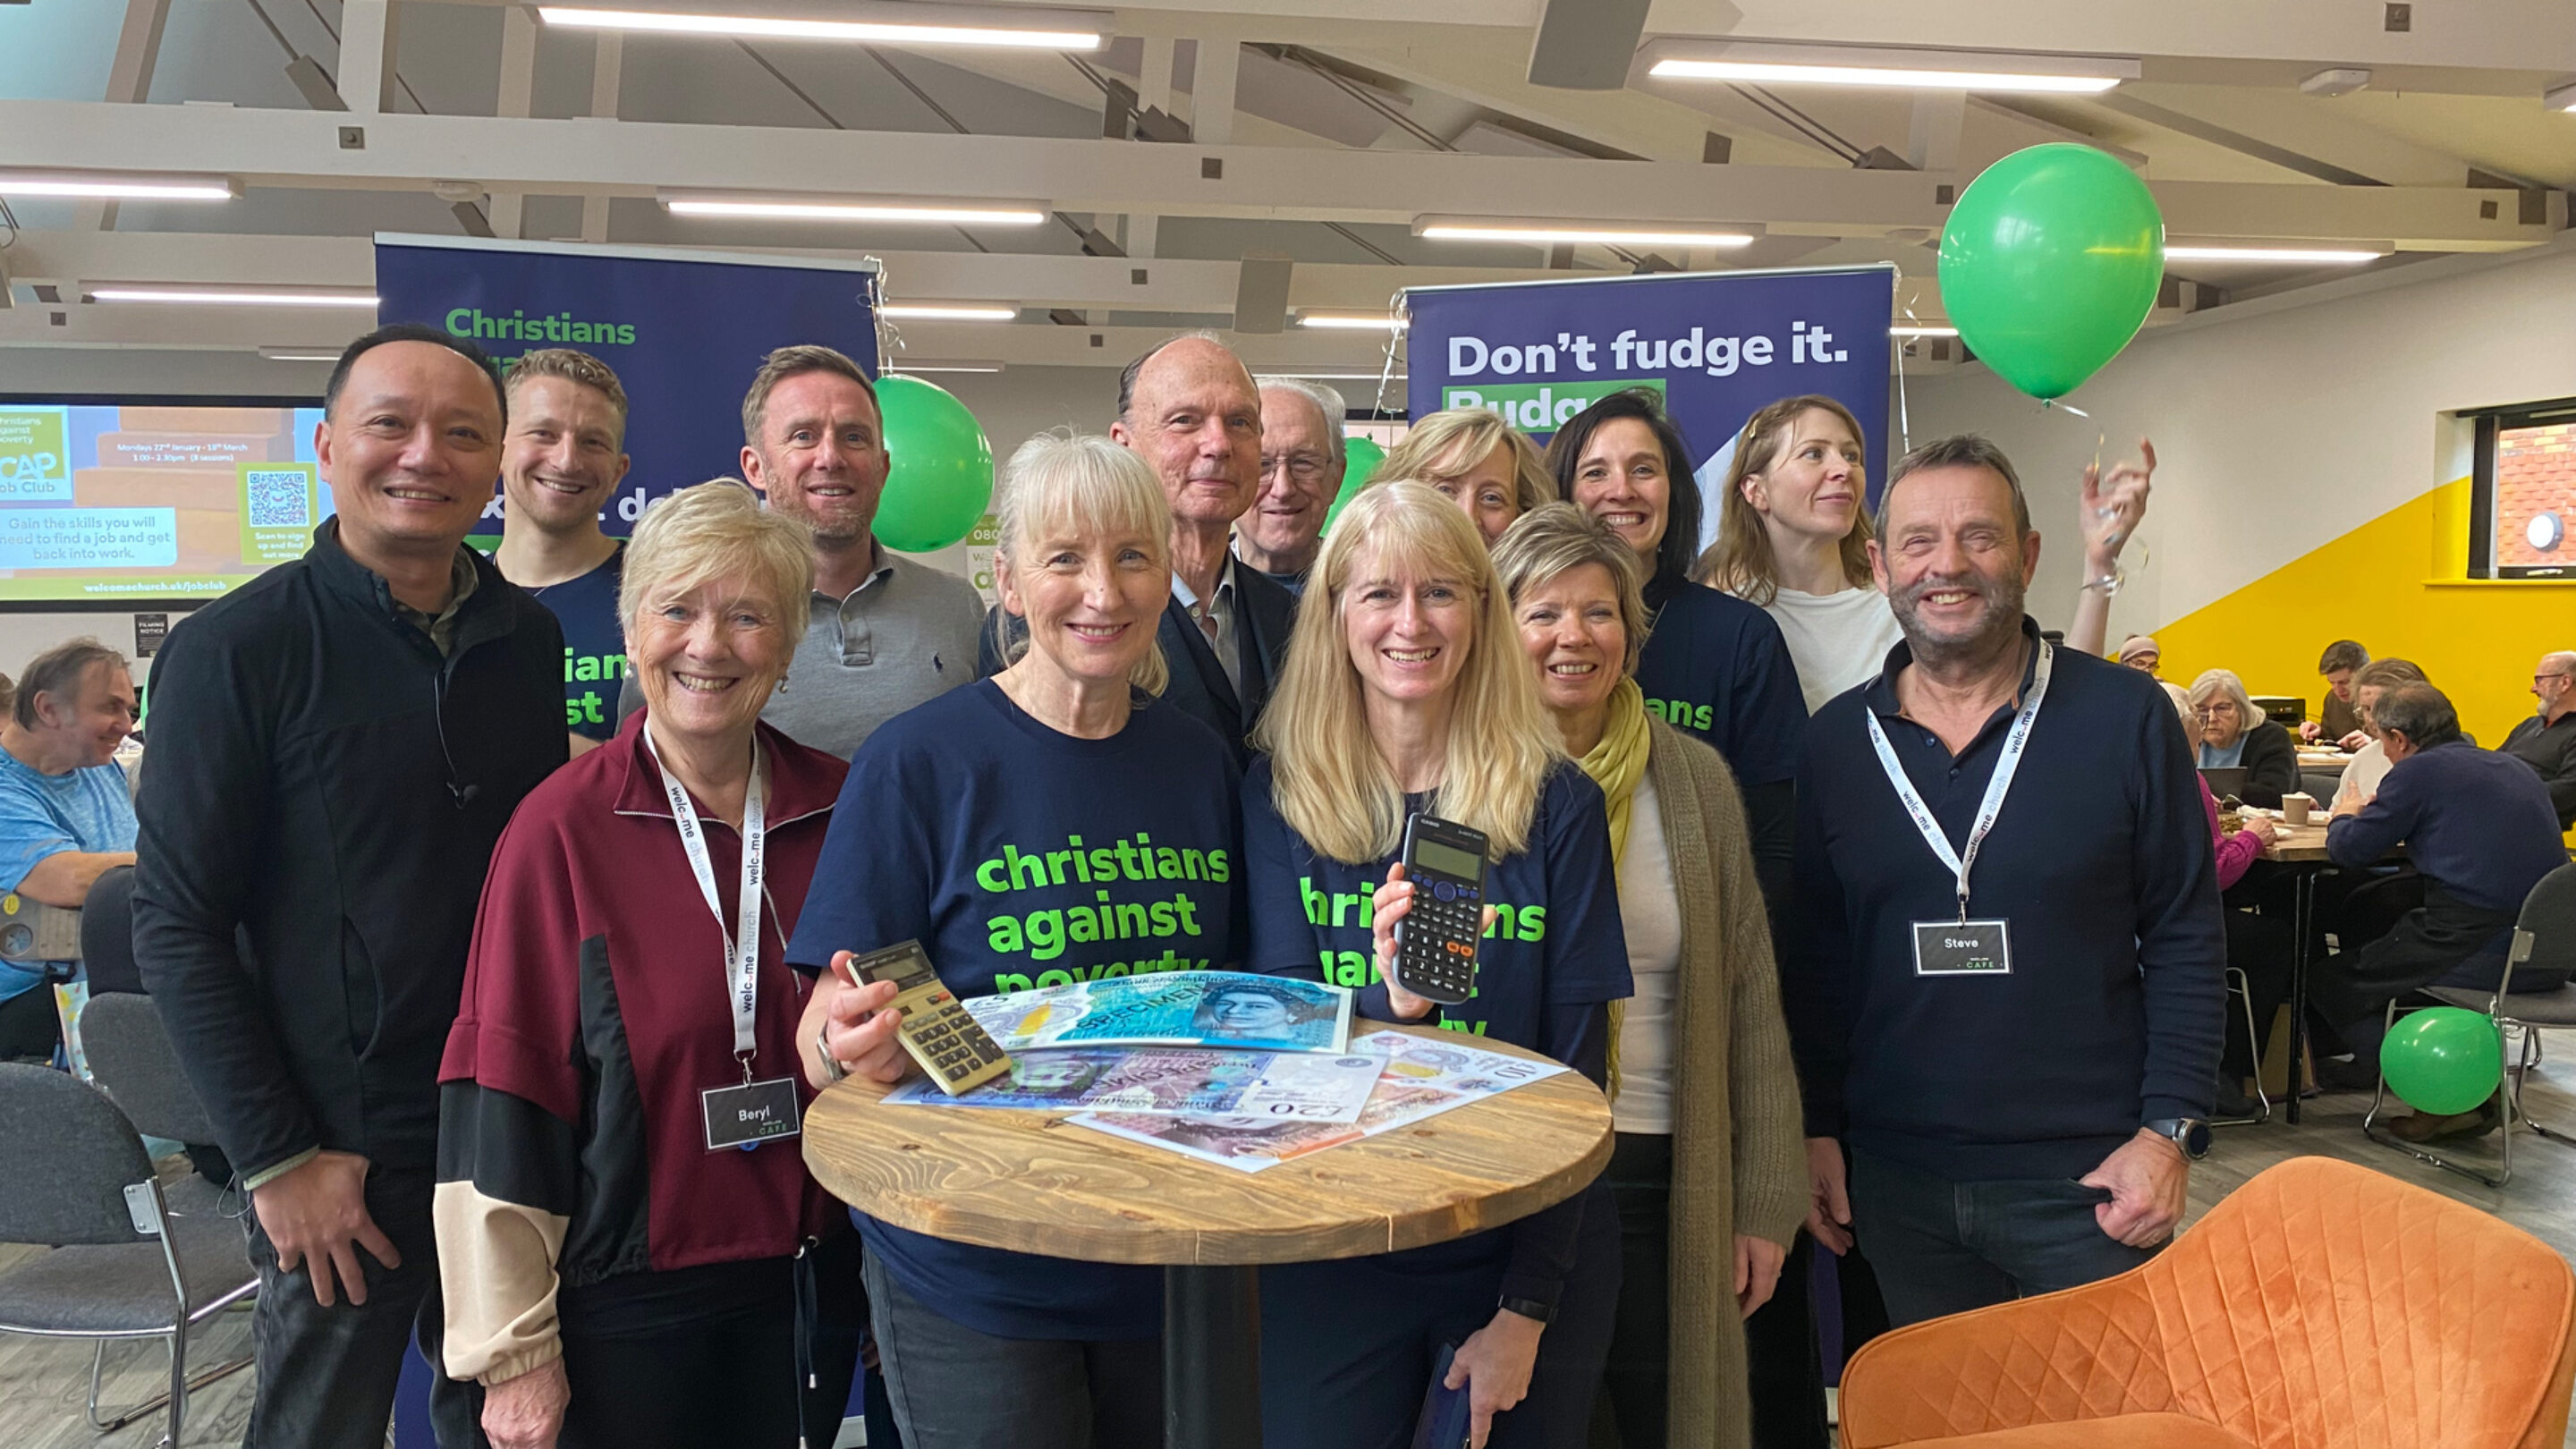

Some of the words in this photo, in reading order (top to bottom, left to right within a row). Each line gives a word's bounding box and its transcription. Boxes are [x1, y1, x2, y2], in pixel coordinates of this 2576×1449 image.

[445, 308, 636, 345] Christians
[1449, 333, 1597, 377] Don't
[1611, 327, 1774, 377] fudge
[1792, 321, 1848, 363] it.
[0, 418, 41, 426] hristians
[0, 427, 30, 435] gainst
[0, 436, 34, 445] overty
[223, 443, 248, 452] March
[0, 452, 56, 480] CAP
[0, 482, 16, 493] ob
[21, 481, 55, 493] Club
[9, 518, 40, 530] Gain
[45, 518, 65, 529] the
[69, 516, 102, 528] skills
[106, 518, 130, 530] you
[133, 516, 156, 528] will
[38, 534, 51, 544] to
[55, 533, 80, 544] find
[84, 535, 91, 543] a
[94, 533, 115, 546] job
[119, 532, 144, 543] and
[148, 532, 171, 546] get
[255, 532, 275, 540] Scan
[287, 533, 306, 542] sign
[270, 541, 285, 549] and
[287, 540, 303, 549] find
[34, 549, 66, 560] back
[69, 548, 96, 559] into
[98, 547, 135, 558] work.
[84, 581, 226, 592] welcomechurch.uk/jobclub
[1877, 742, 1898, 776] church
[1989, 775, 2009, 813] church
[1929, 831, 1955, 866] church
[689, 841, 711, 884] church
[976, 833, 1230, 893] christians
[745, 911, 758, 953] church
[987, 890, 1202, 961] against
[1945, 938, 1979, 949] Steve
[1077, 982, 1205, 1030] SPECIMEN
[738, 1105, 770, 1122] Beryl
[1270, 1103, 1349, 1117] £20
[758, 1123, 787, 1136] CAFE
